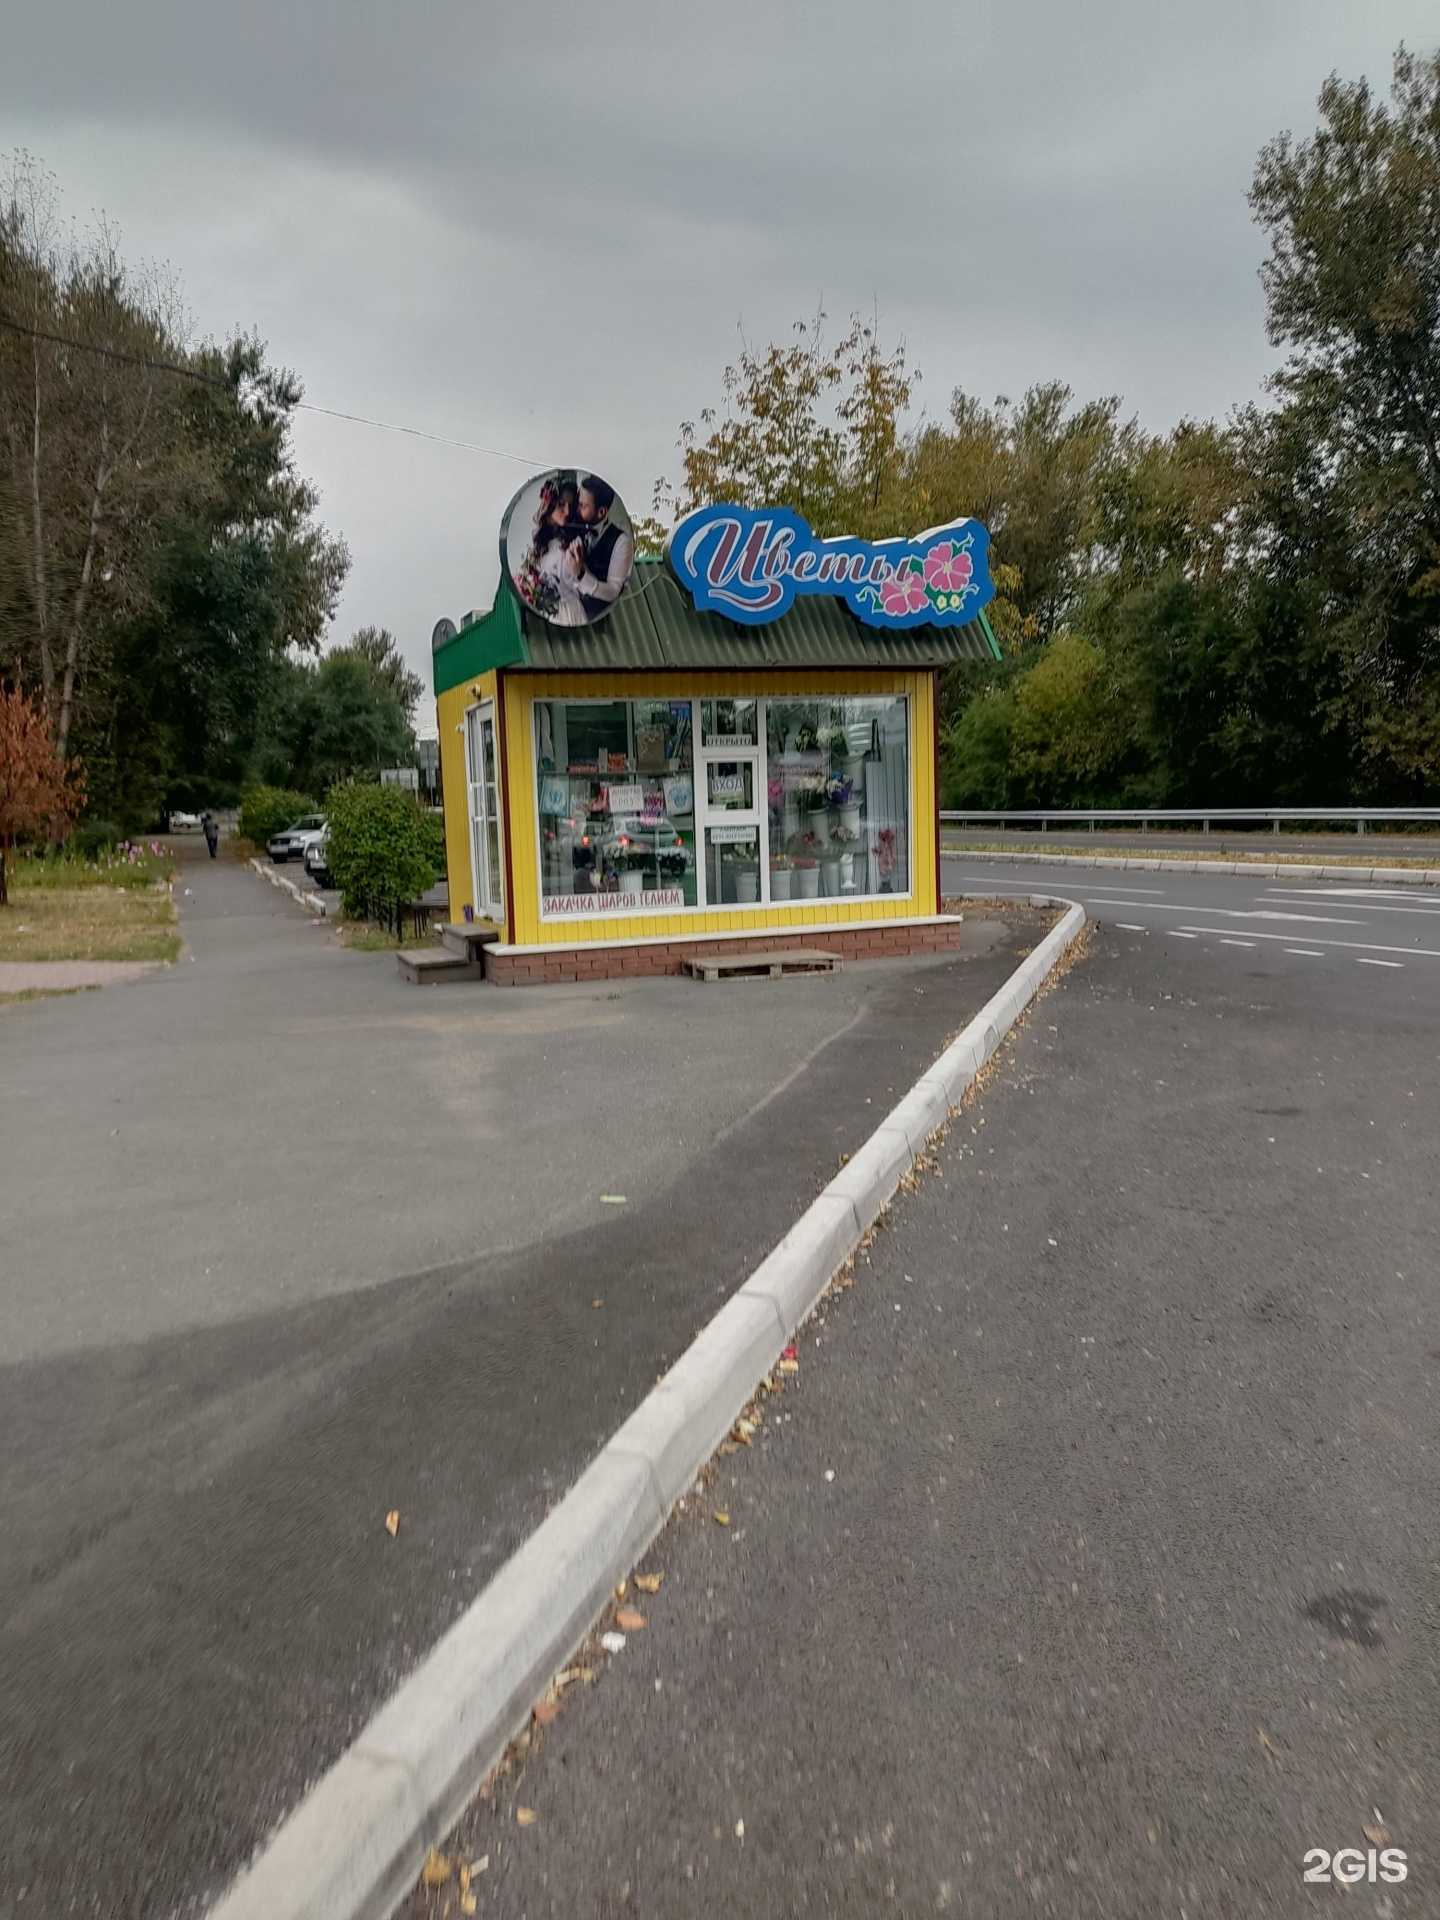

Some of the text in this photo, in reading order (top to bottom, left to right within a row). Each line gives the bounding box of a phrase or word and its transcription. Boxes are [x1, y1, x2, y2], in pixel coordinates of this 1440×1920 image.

[684, 517, 915, 612] Цветы
[712, 776, 744, 793] ВХОД
[544, 889, 680, 912] ЗАКАЧКА ШАРОВ ГЕЛИЕМ
